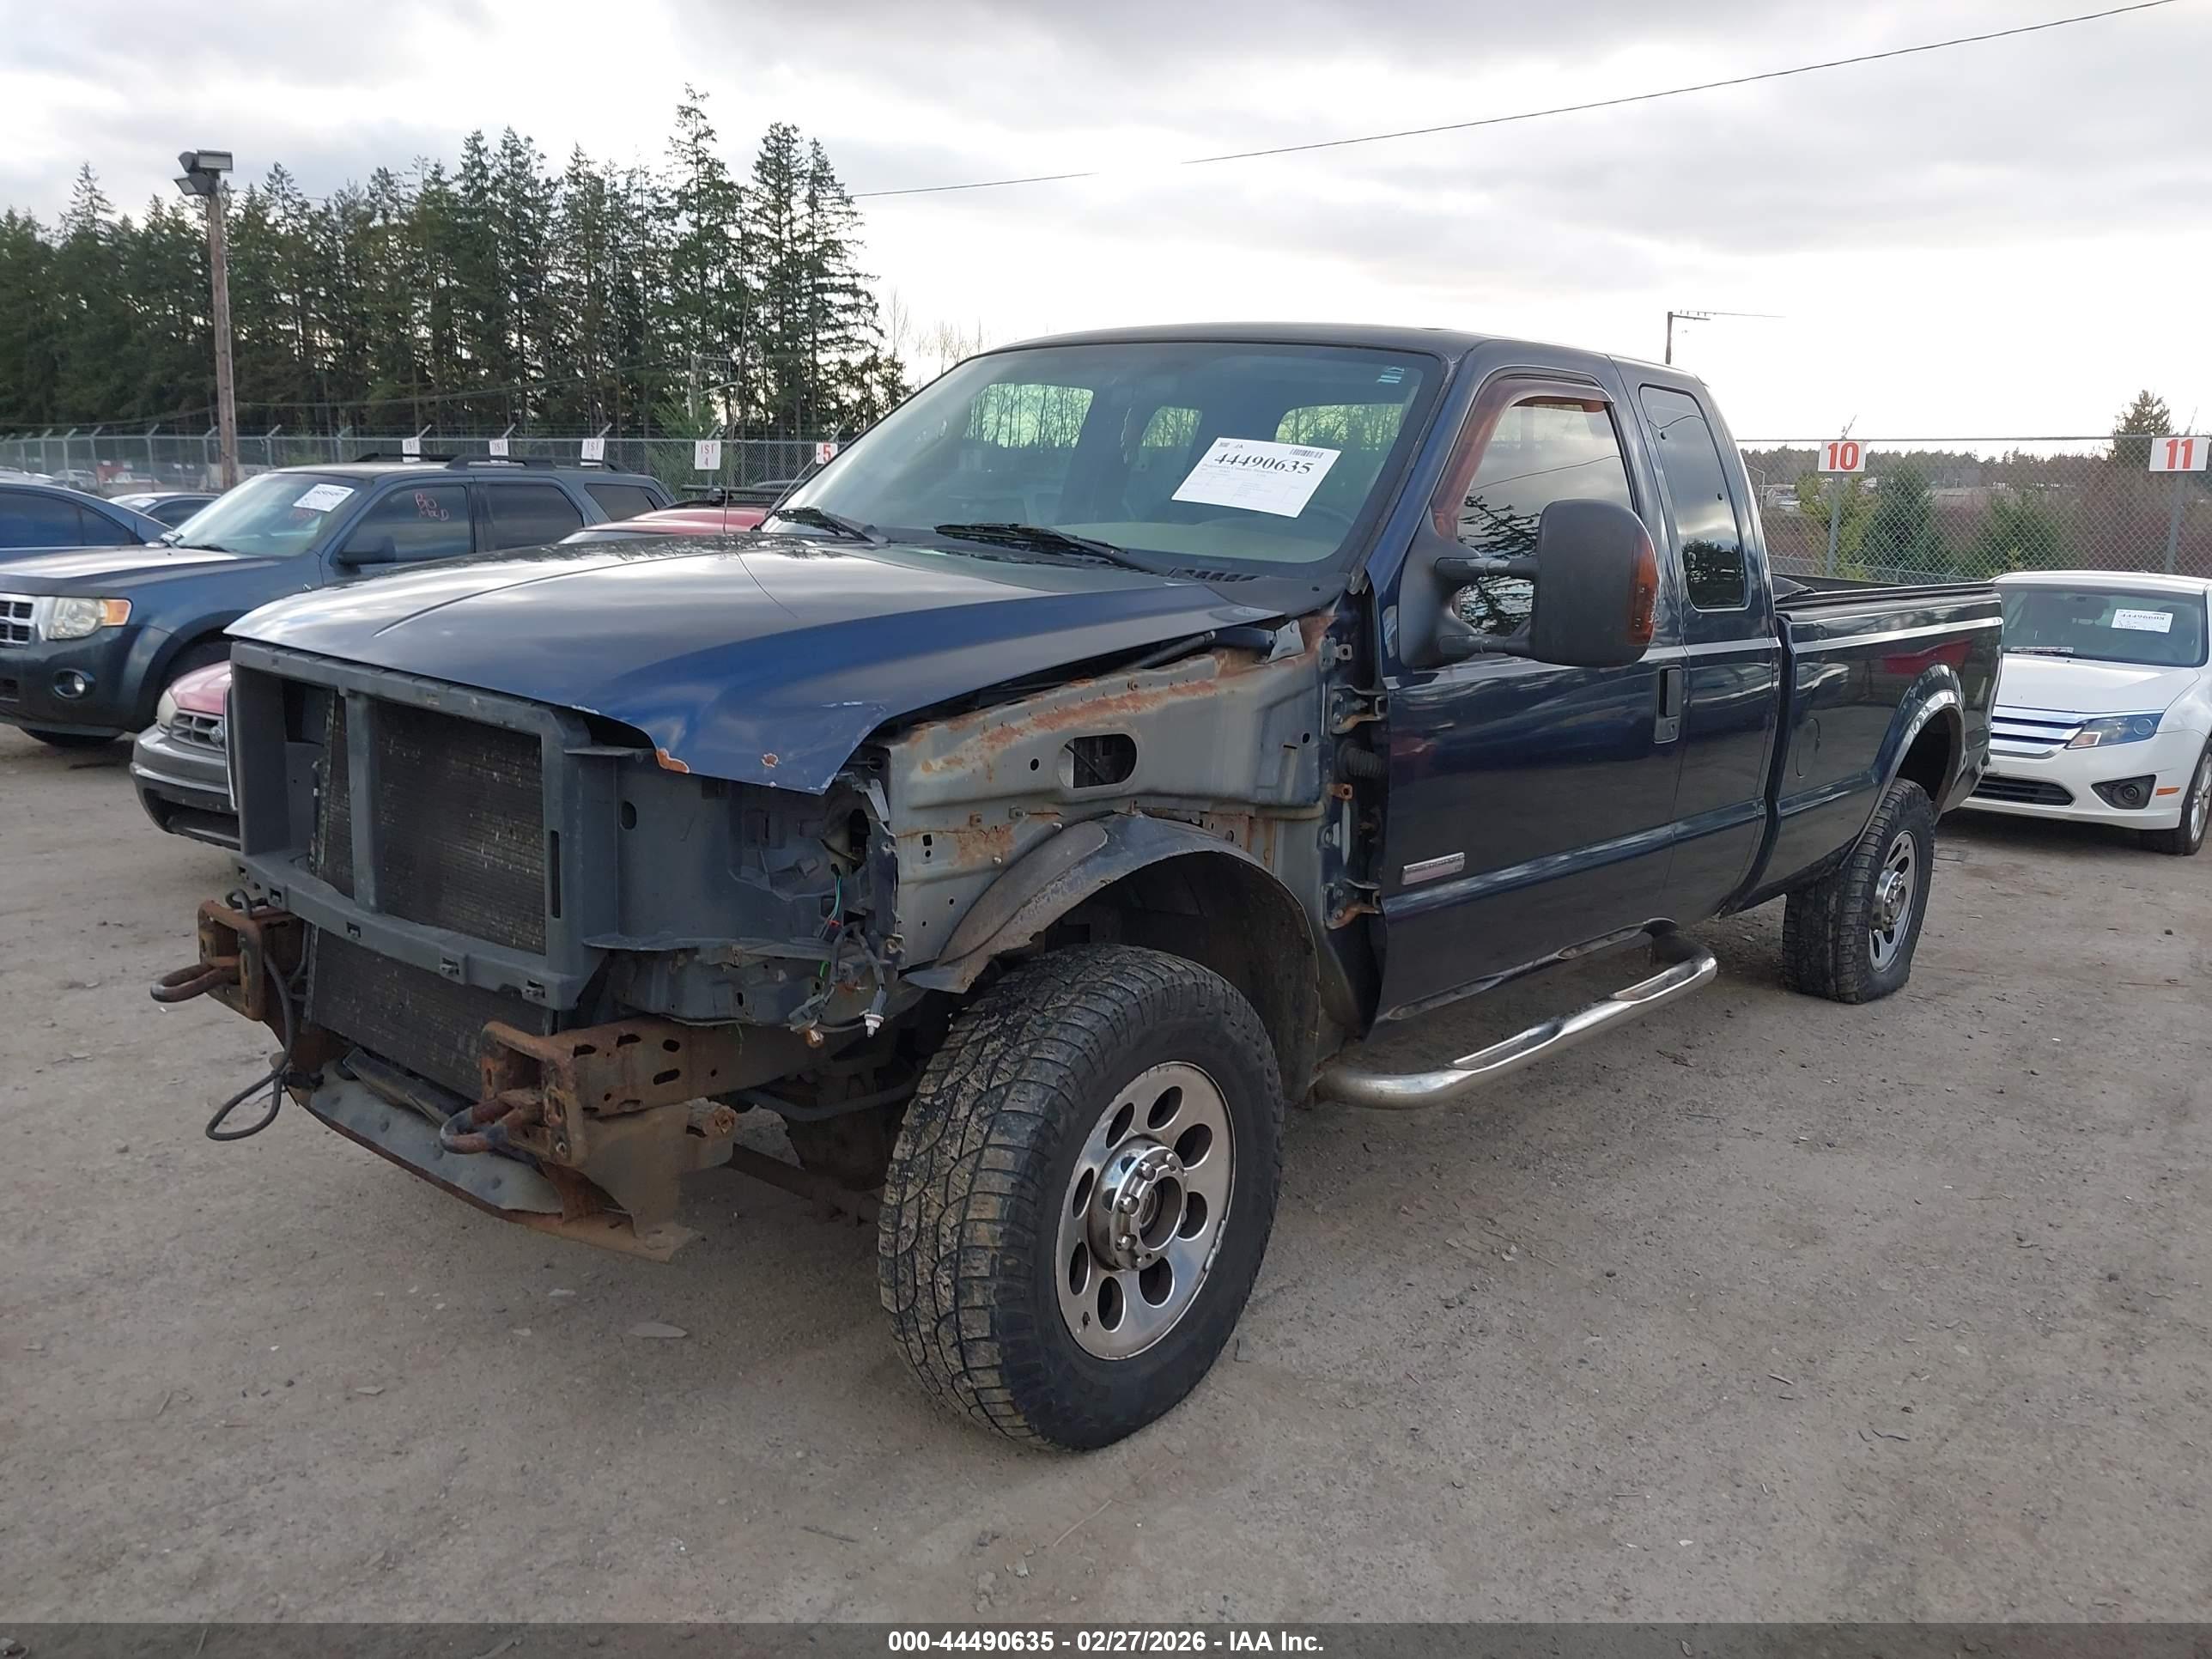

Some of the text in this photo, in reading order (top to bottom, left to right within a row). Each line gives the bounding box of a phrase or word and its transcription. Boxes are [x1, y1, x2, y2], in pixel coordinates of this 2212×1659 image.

[823, 444, 831, 462] 5
[1214, 453, 1316, 475] 44490635
[1827, 441, 1859, 471] 10
[2166, 438, 2194, 470] 11
